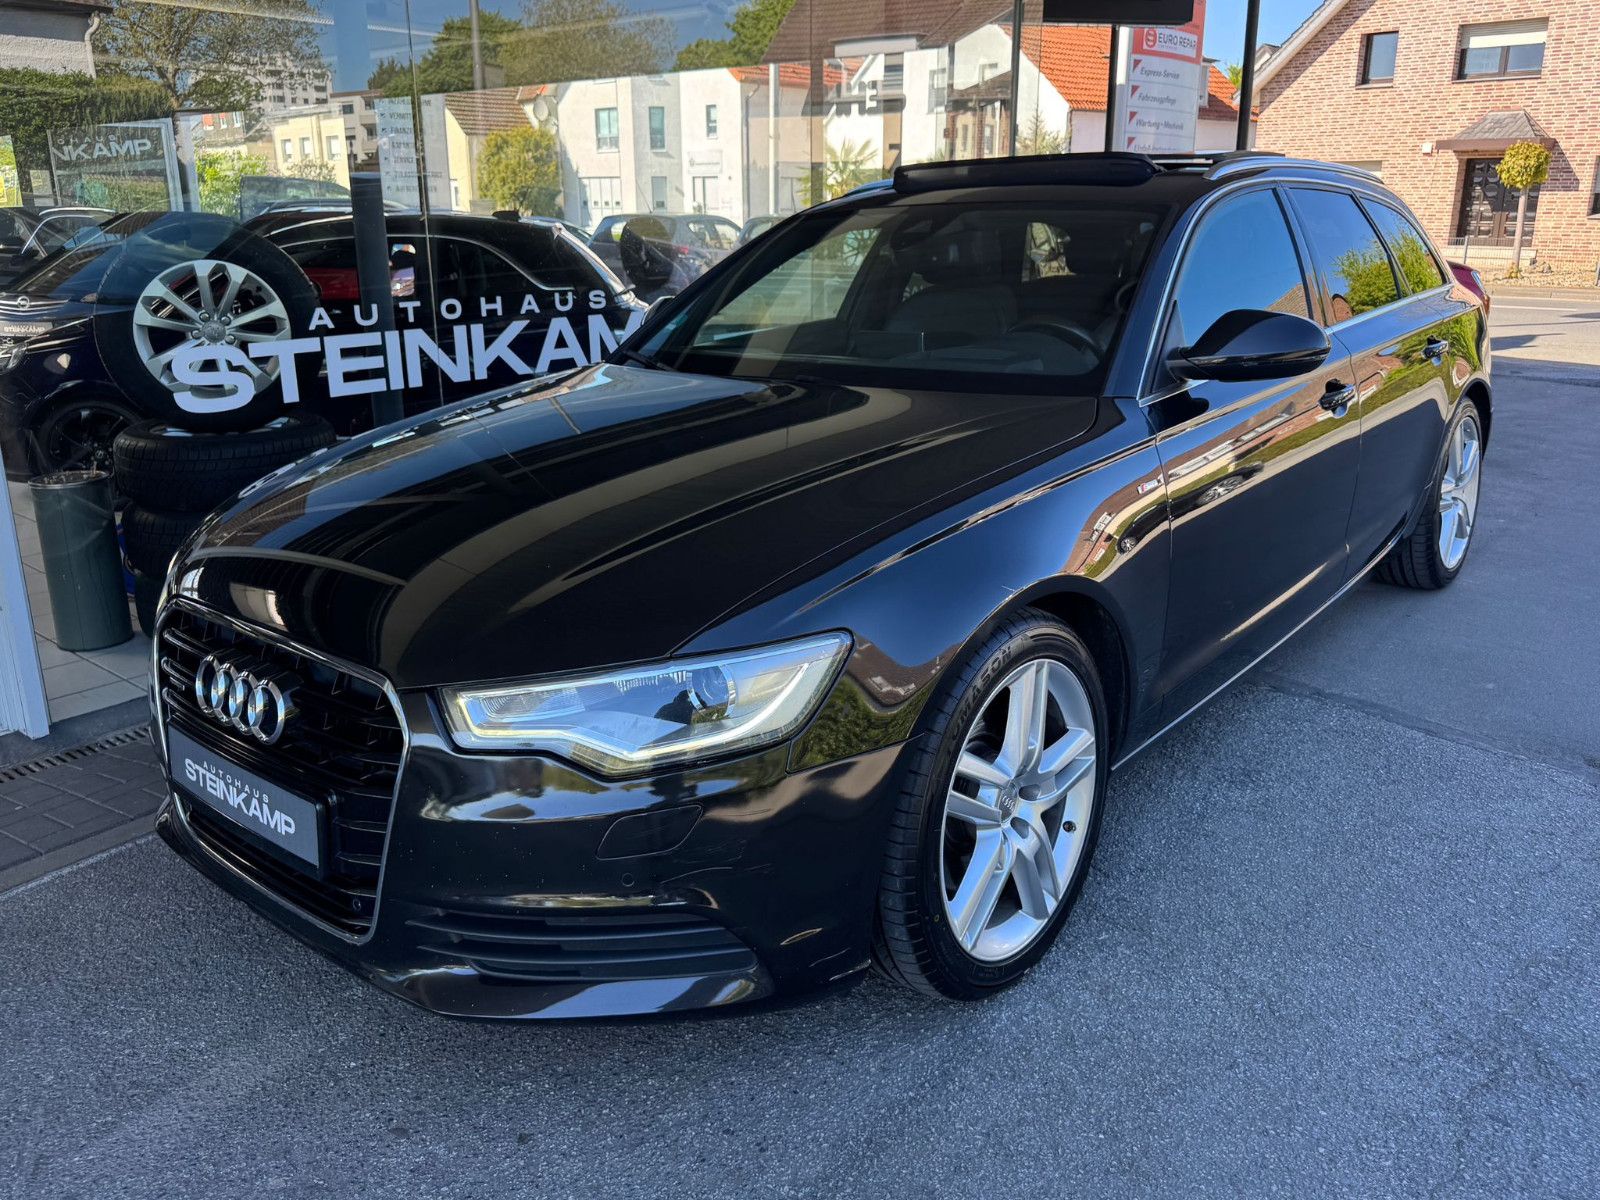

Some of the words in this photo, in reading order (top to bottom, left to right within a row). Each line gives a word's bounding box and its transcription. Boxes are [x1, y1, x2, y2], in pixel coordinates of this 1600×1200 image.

[1158, 32, 1178, 45] EURO
[51, 138, 151, 161] NKAMP
[308, 290, 607, 331] AUTOHAUS
[172, 311, 642, 414] STEINKAM
[184, 758, 296, 835] STEINKAMP
[203, 761, 269, 803] AUTOHAUS
